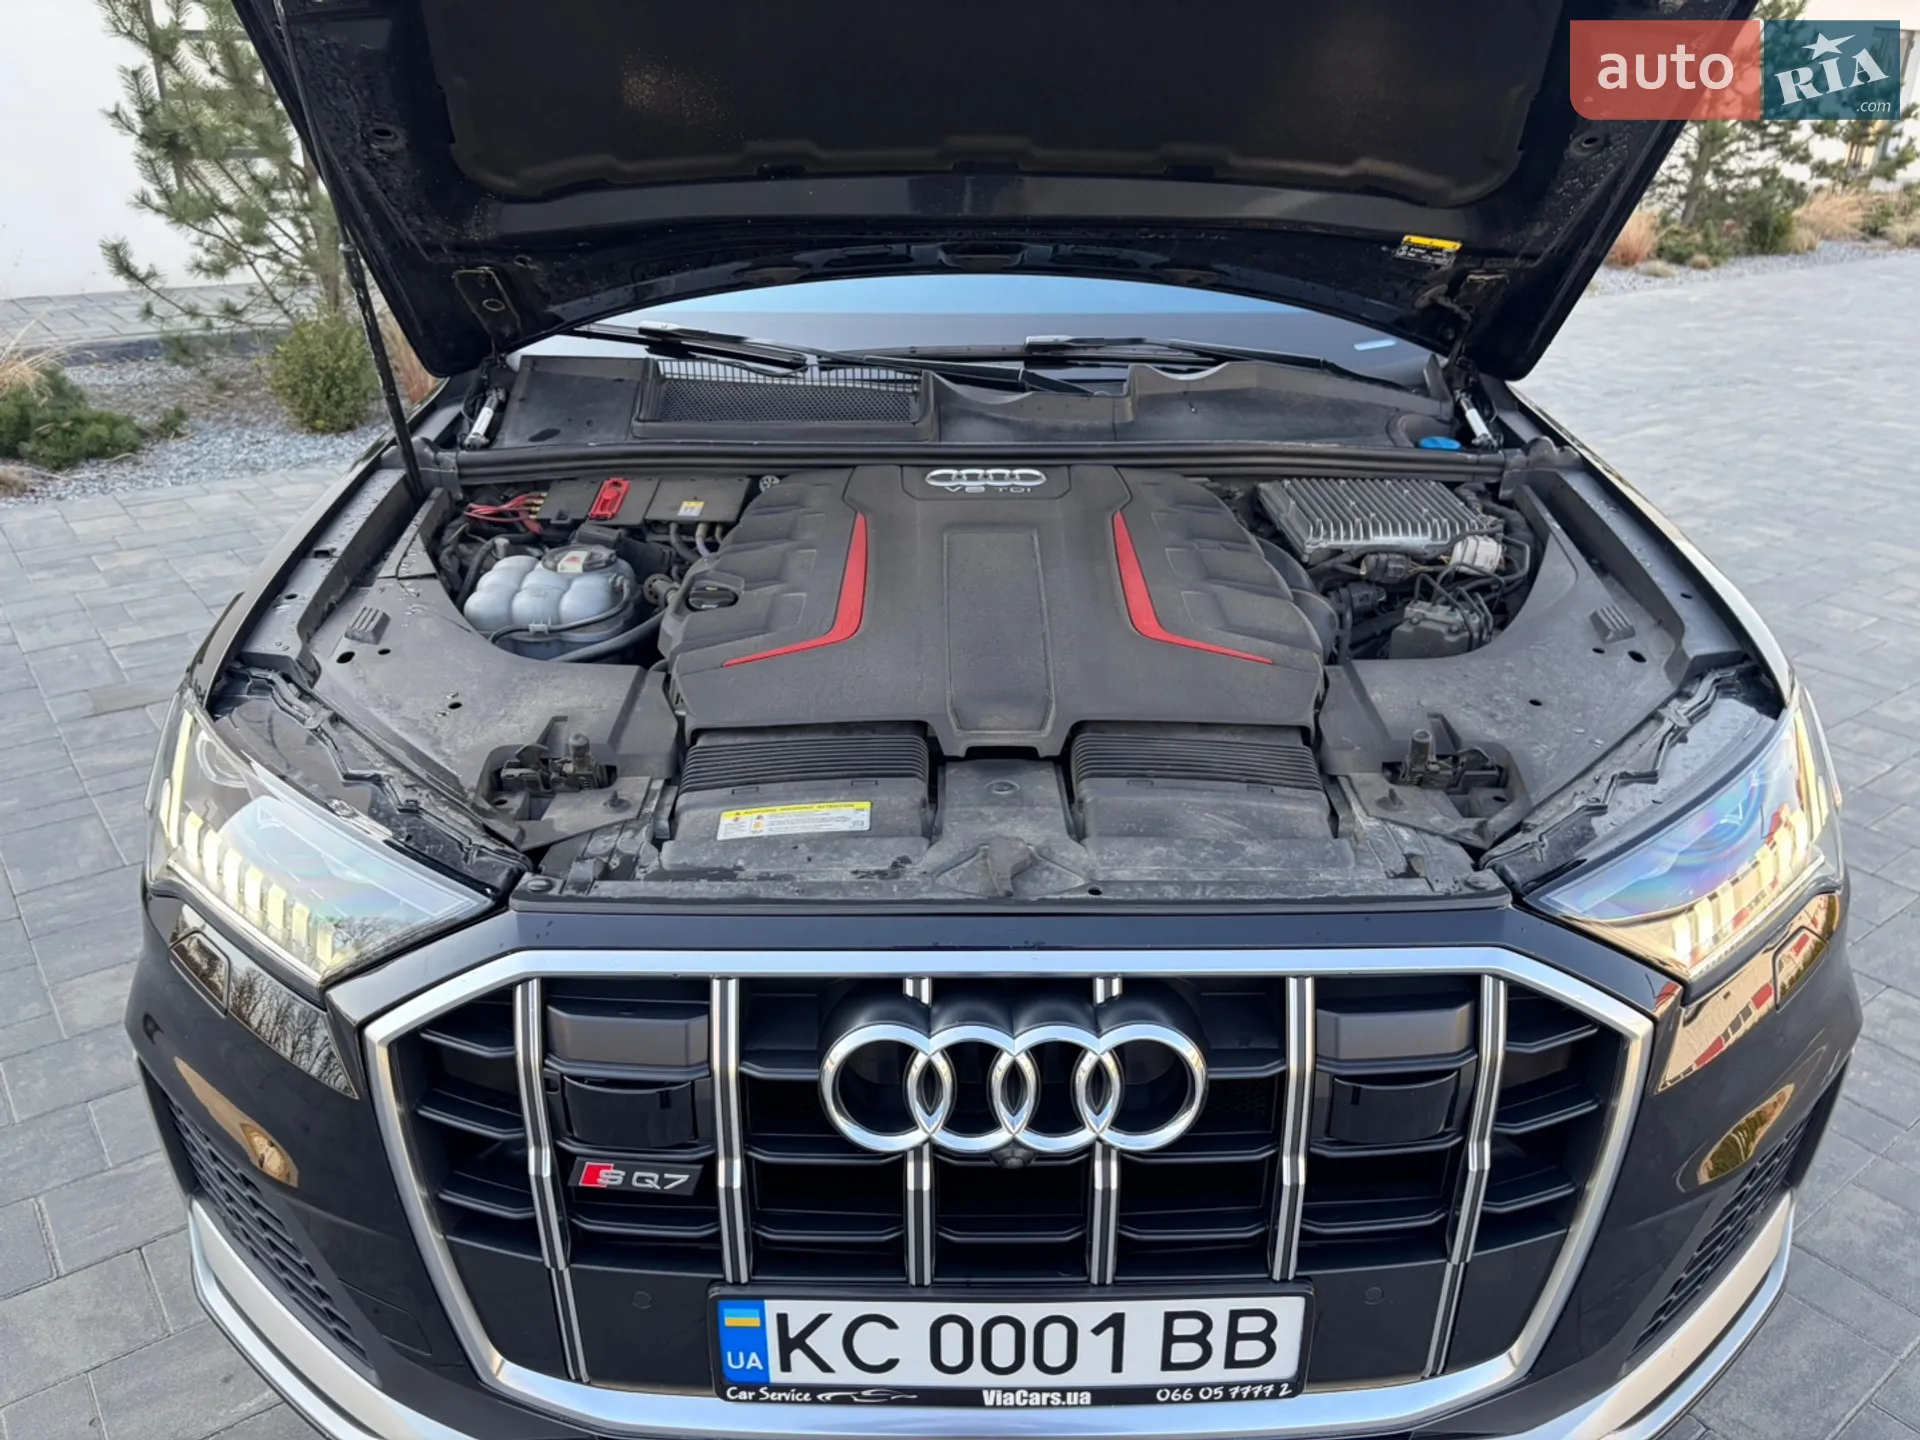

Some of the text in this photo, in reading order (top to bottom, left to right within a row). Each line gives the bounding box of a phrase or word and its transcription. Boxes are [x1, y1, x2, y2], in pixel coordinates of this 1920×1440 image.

[776, 1308, 1278, 1375] KC 0001 BB
[727, 1351, 763, 1370] UA
[726, 1386, 812, 1401] Car Service
[982, 1389, 1092, 1406] ViaCars.ua
[1156, 1383, 1292, 1402] 066 05 7777 2
